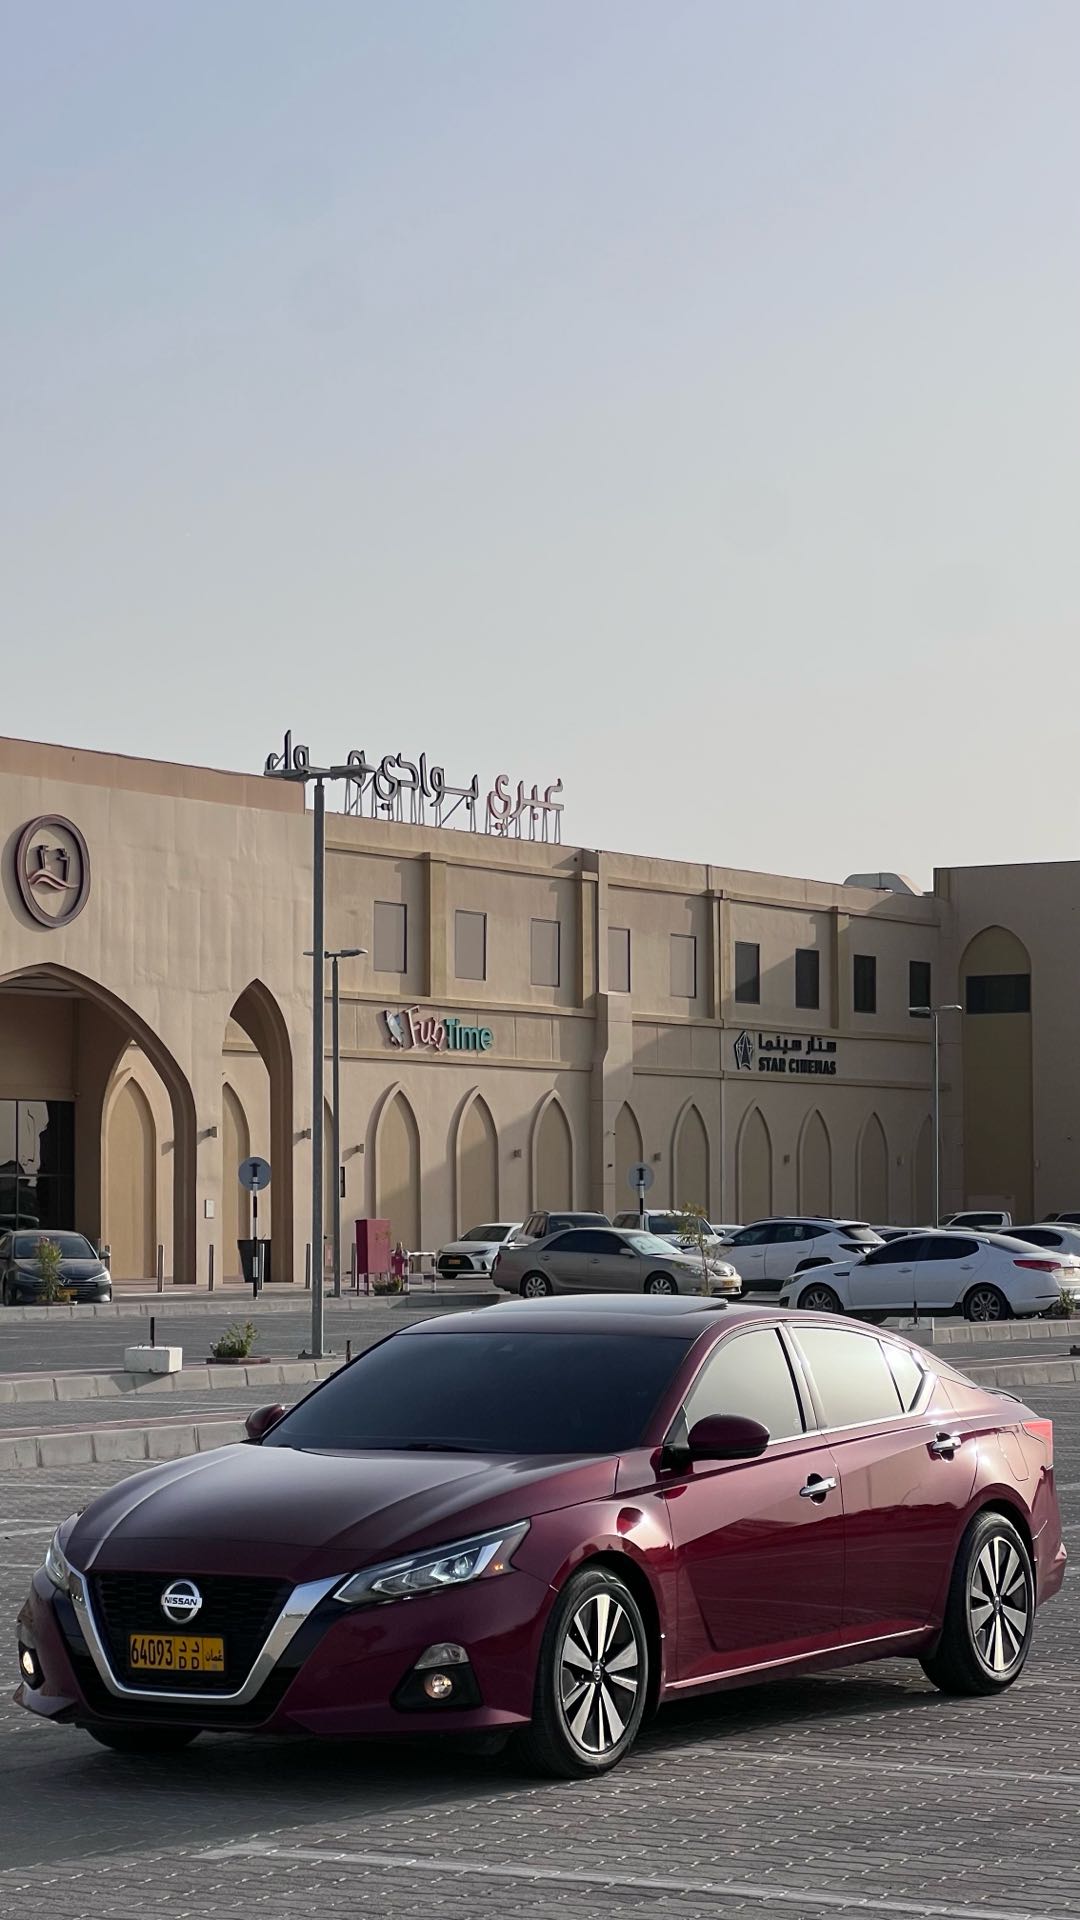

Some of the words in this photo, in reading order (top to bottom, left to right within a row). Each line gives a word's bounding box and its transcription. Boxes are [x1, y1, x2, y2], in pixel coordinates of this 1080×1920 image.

[373, 752, 479, 811] بوادي
[487, 775, 564, 829] عبري
[758, 1033, 802, 1055] سينما
[806, 1035, 837, 1055] ستار
[758, 1056, 786, 1073] STAR
[788, 1058, 837, 1075] CINEMAS
[164, 1596, 198, 1606] NISSAN
[131, 1638, 173, 1666] 64093
